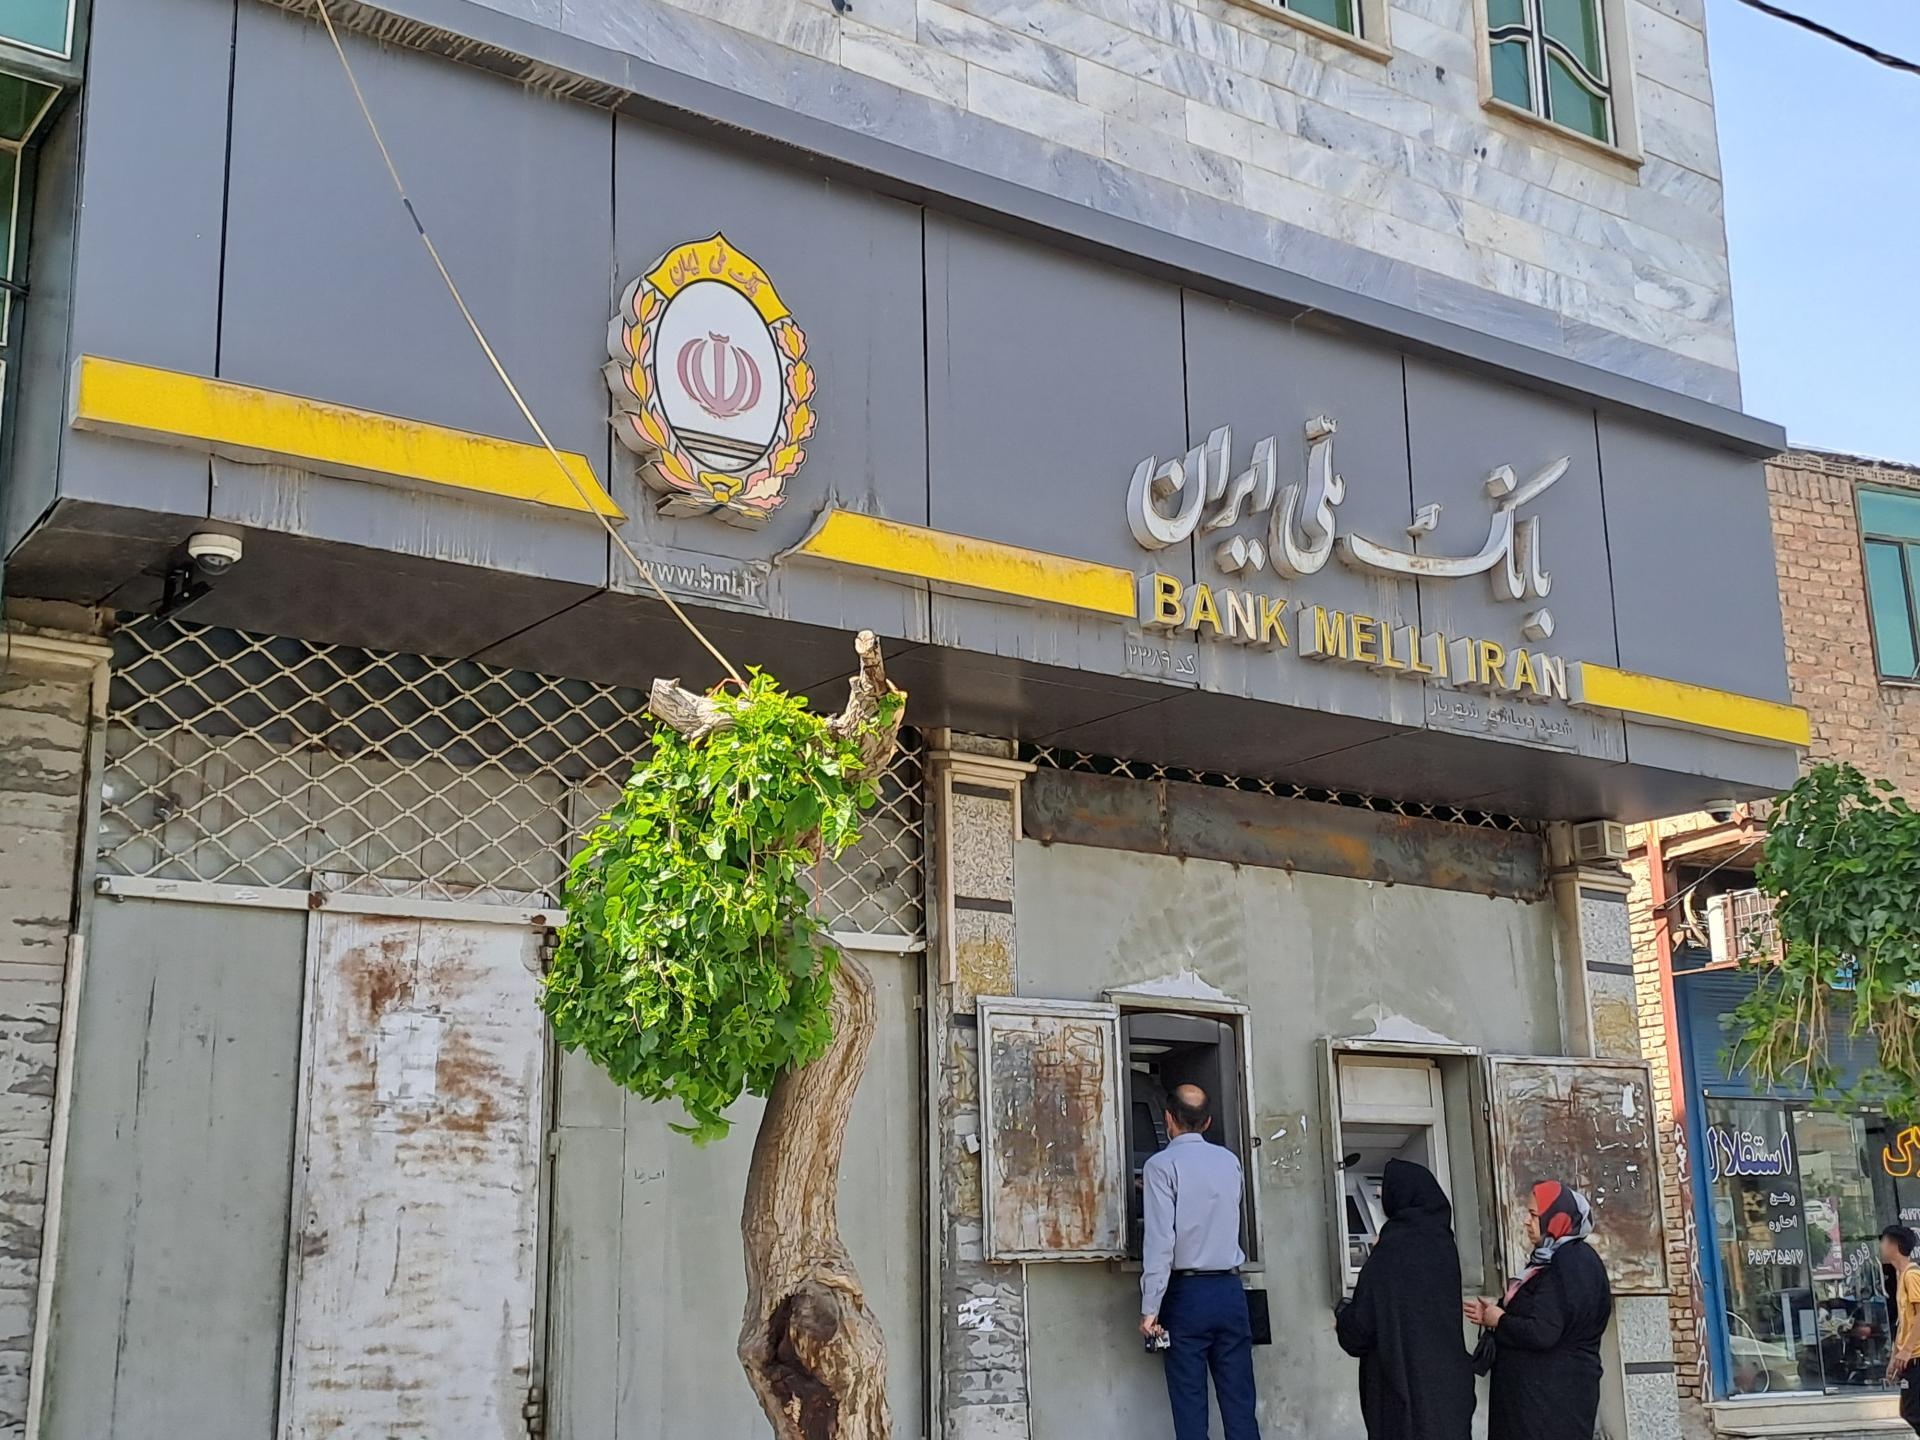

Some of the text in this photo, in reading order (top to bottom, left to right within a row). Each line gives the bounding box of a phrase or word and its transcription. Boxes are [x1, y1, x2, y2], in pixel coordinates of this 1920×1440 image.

[669, 247, 700, 287] ایران
[1126, 424, 1278, 574] ایران
[1336, 455, 1571, 642] بانک
[640, 559, 760, 598] www.bmi.ir
[1150, 572, 1568, 701] BANK MELLI IRAN
[1175, 653, 1196, 675] کد
[1429, 693, 1480, 723] شهریار
[1706, 1126, 1792, 1183] استقلال
